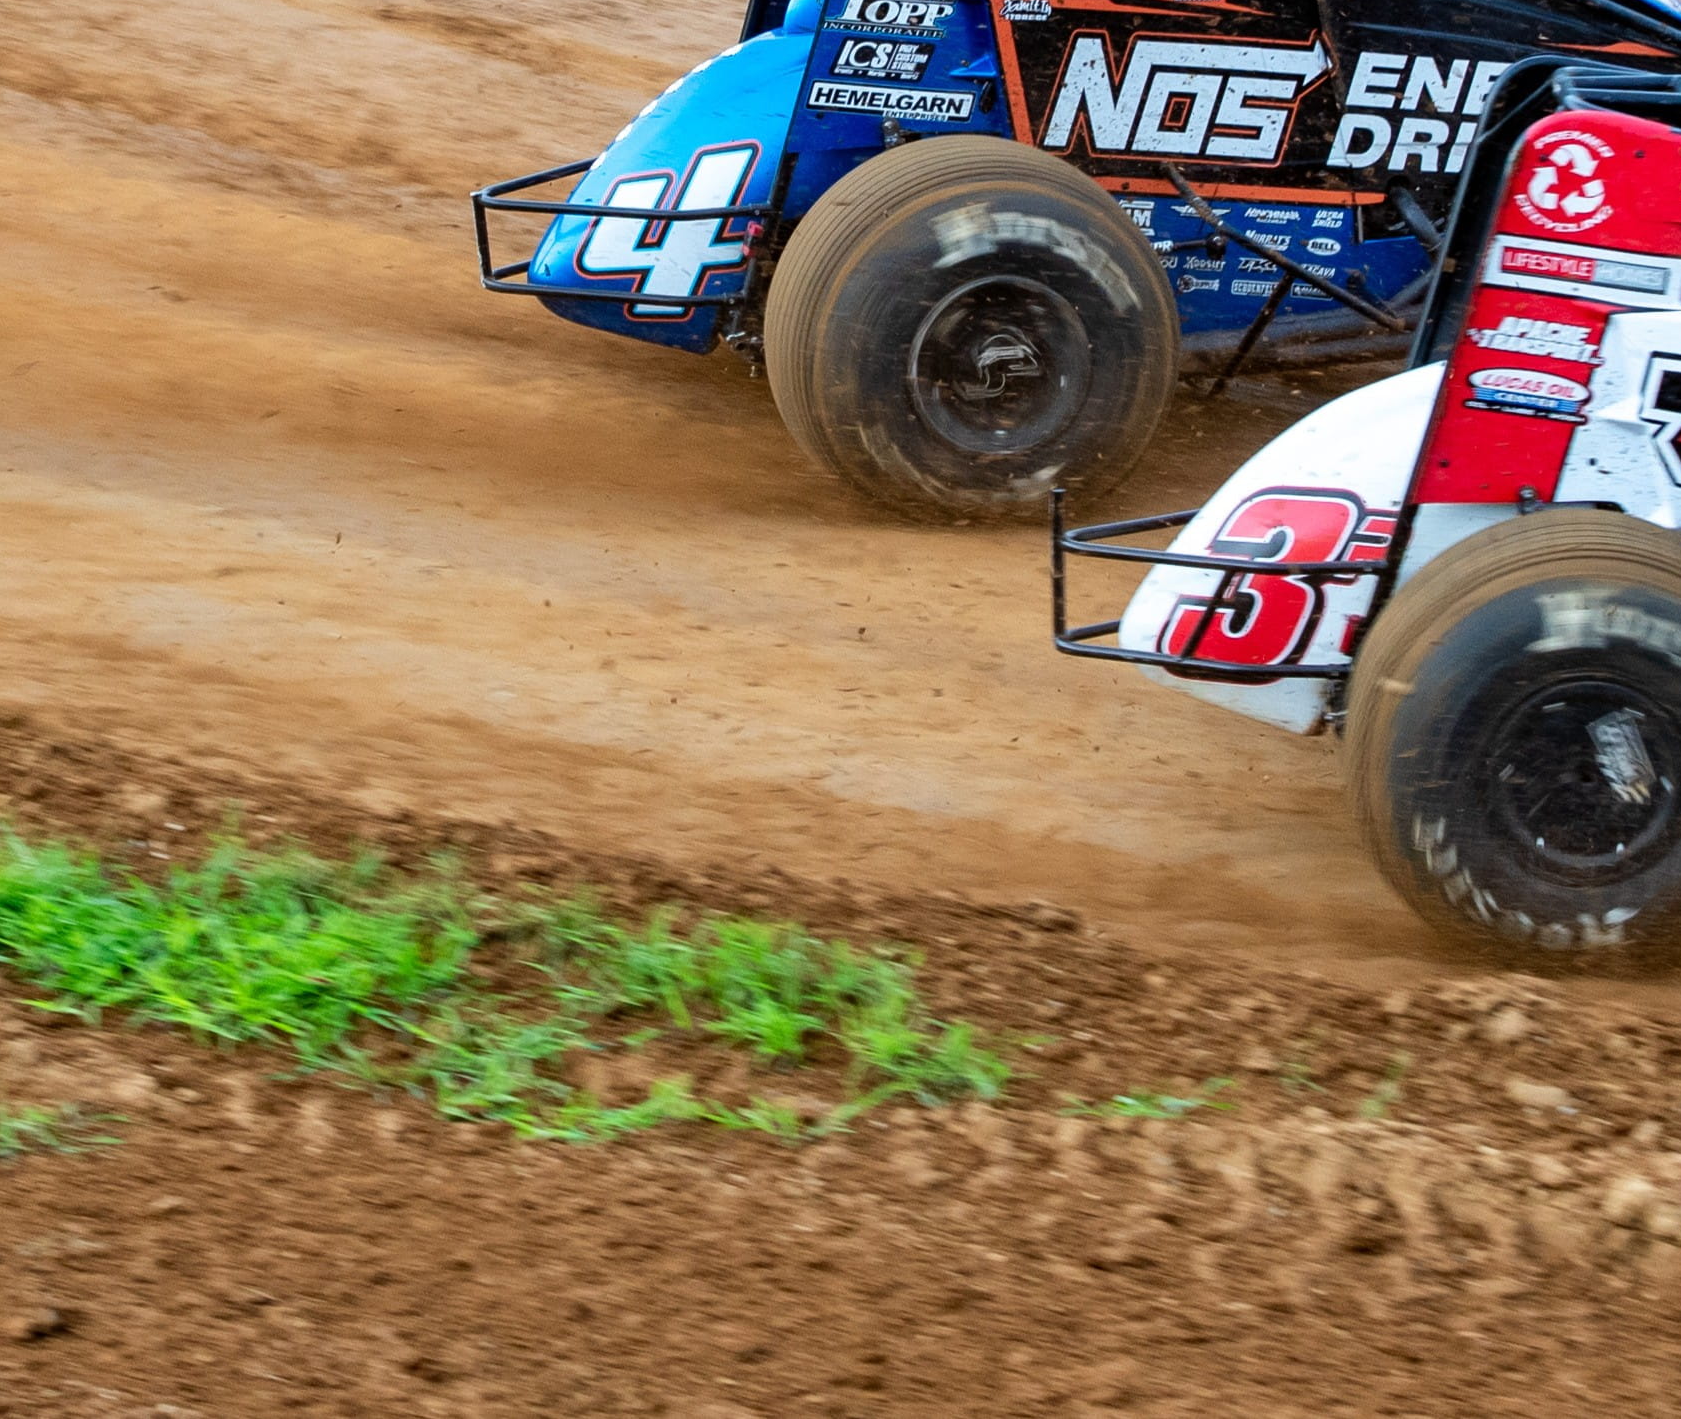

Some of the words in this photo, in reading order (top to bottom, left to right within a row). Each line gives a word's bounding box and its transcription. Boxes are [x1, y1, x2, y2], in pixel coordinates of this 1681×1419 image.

[823, 21, 946, 39] INCORPORATED
[837, 39, 894, 69] ICS
[1346, 51, 1509, 115] ENE
[814, 86, 964, 115] HEMELGARN
[1043, 37, 1332, 160] NOS
[884, 110, 948, 122] ENTERPRISES
[1326, 113, 1478, 173] DRI
[1312, 218, 1343, 229] SHIELD
[1315, 210, 1344, 220] ULTRA
[579, 141, 759, 320] 4
[1502, 250, 1594, 277] LIFESTYLE
[1482, 374, 1543, 393] LUCAS
[1547, 381, 1577, 399] OIL
